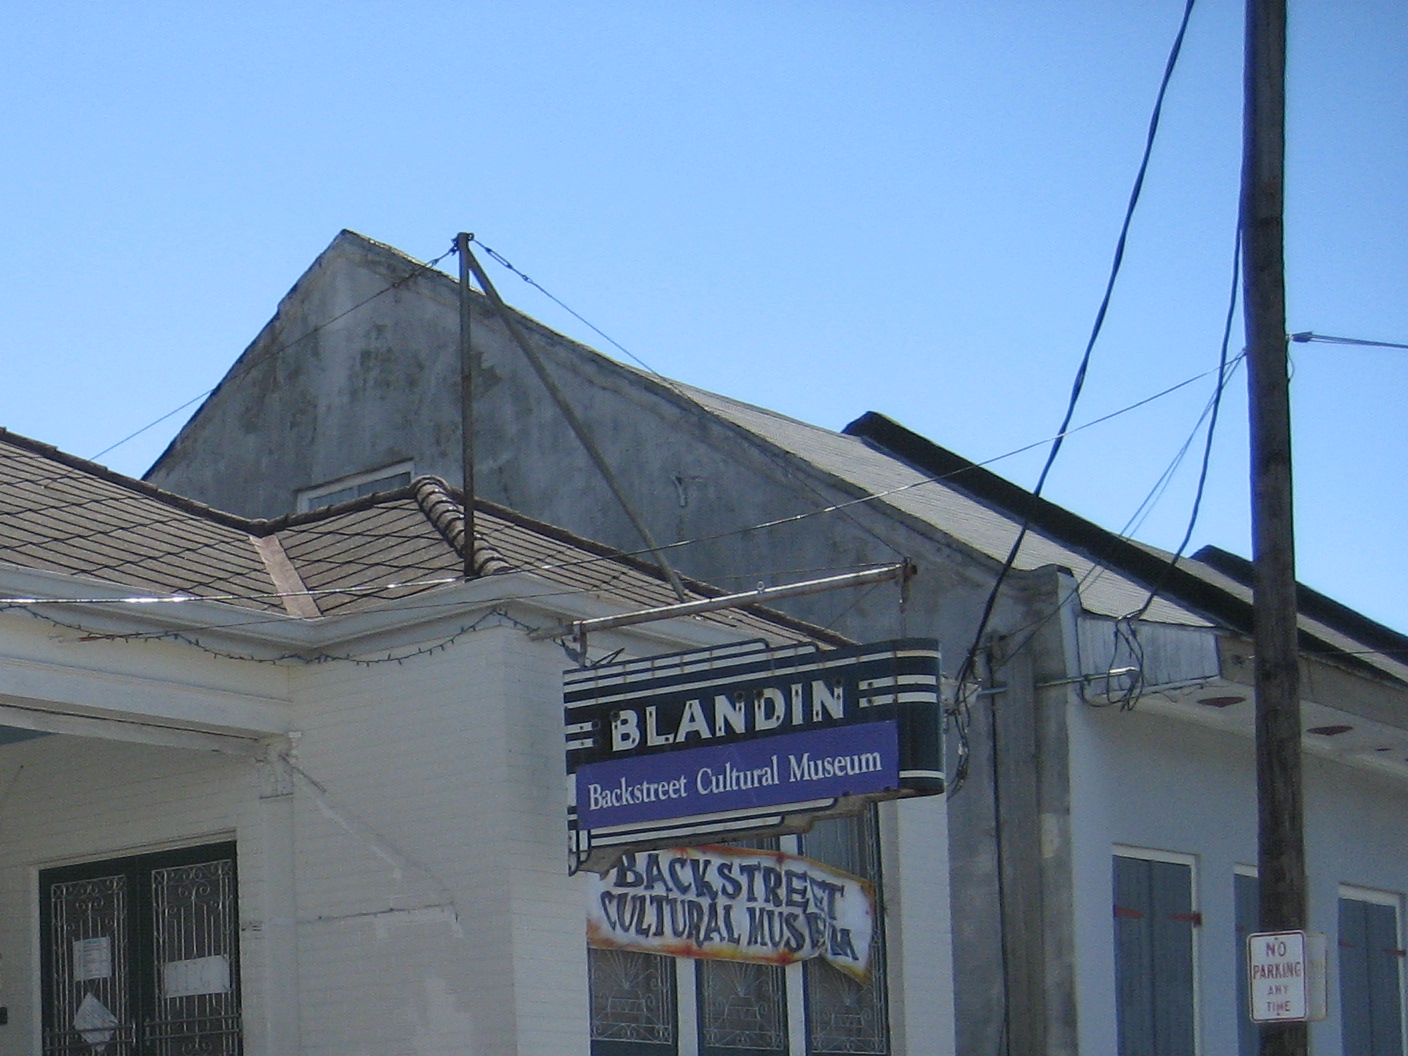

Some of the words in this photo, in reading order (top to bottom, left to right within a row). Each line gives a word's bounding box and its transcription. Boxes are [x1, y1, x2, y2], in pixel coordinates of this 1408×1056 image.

[611, 680, 845, 752] BLANDIN
[588, 775, 688, 811] Backstreet
[696, 755, 780, 796] Cultural
[787, 751, 883, 783] Museum
[600, 890, 742, 948] CULTURAL
[746, 906, 860, 962] MUSEM
[1266, 941, 1287, 958] NO
[1253, 962, 1301, 980] PARKING
[1266, 1001, 1290, 1013] TIME
